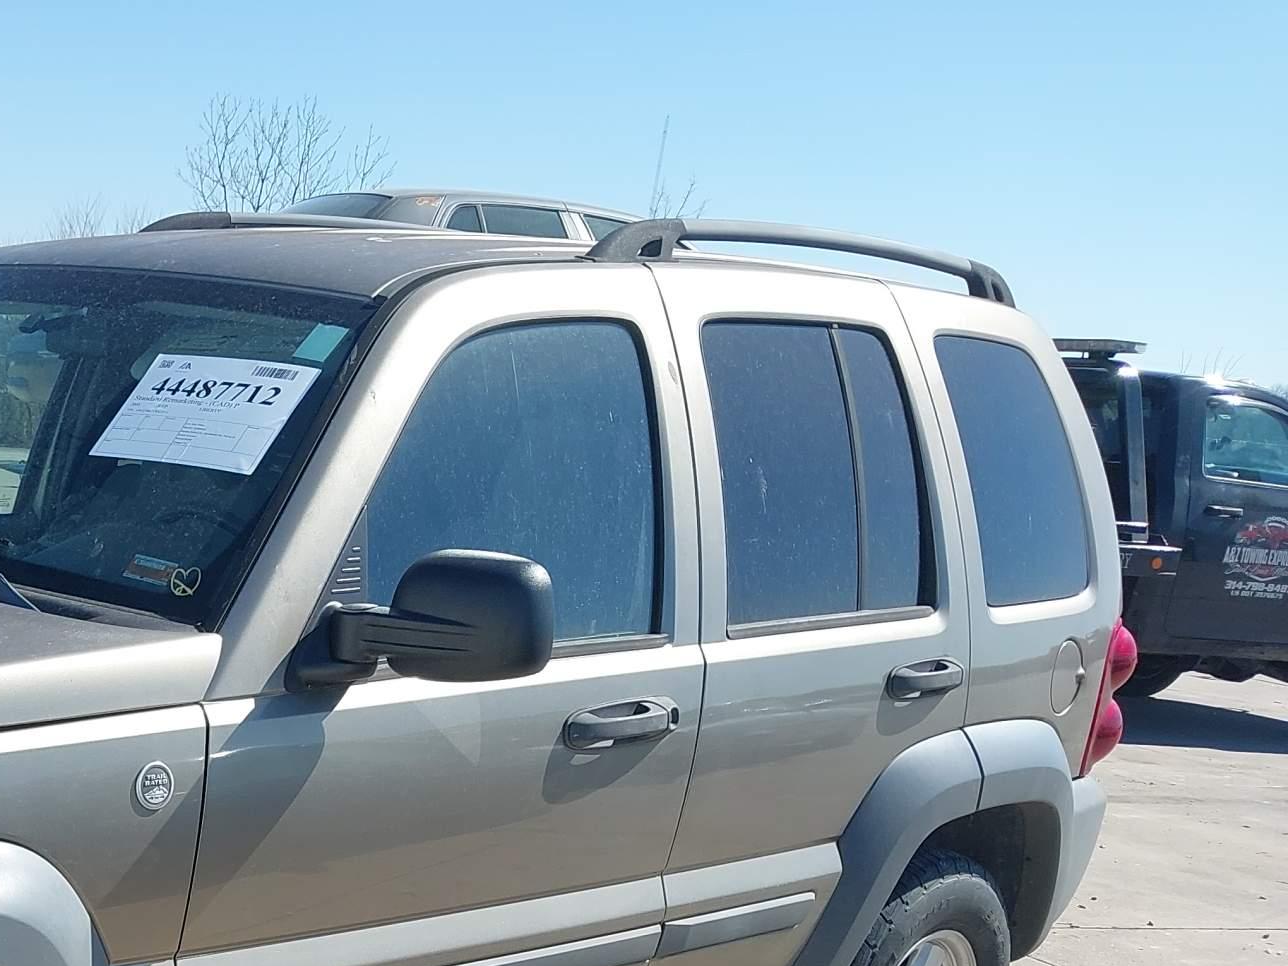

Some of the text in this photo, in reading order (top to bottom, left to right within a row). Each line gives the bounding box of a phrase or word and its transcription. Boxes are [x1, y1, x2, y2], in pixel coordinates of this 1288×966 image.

[151, 377, 282, 406] 44487712
[146, 773, 168, 781] TRAIL
[144, 778, 168, 786] RATED
